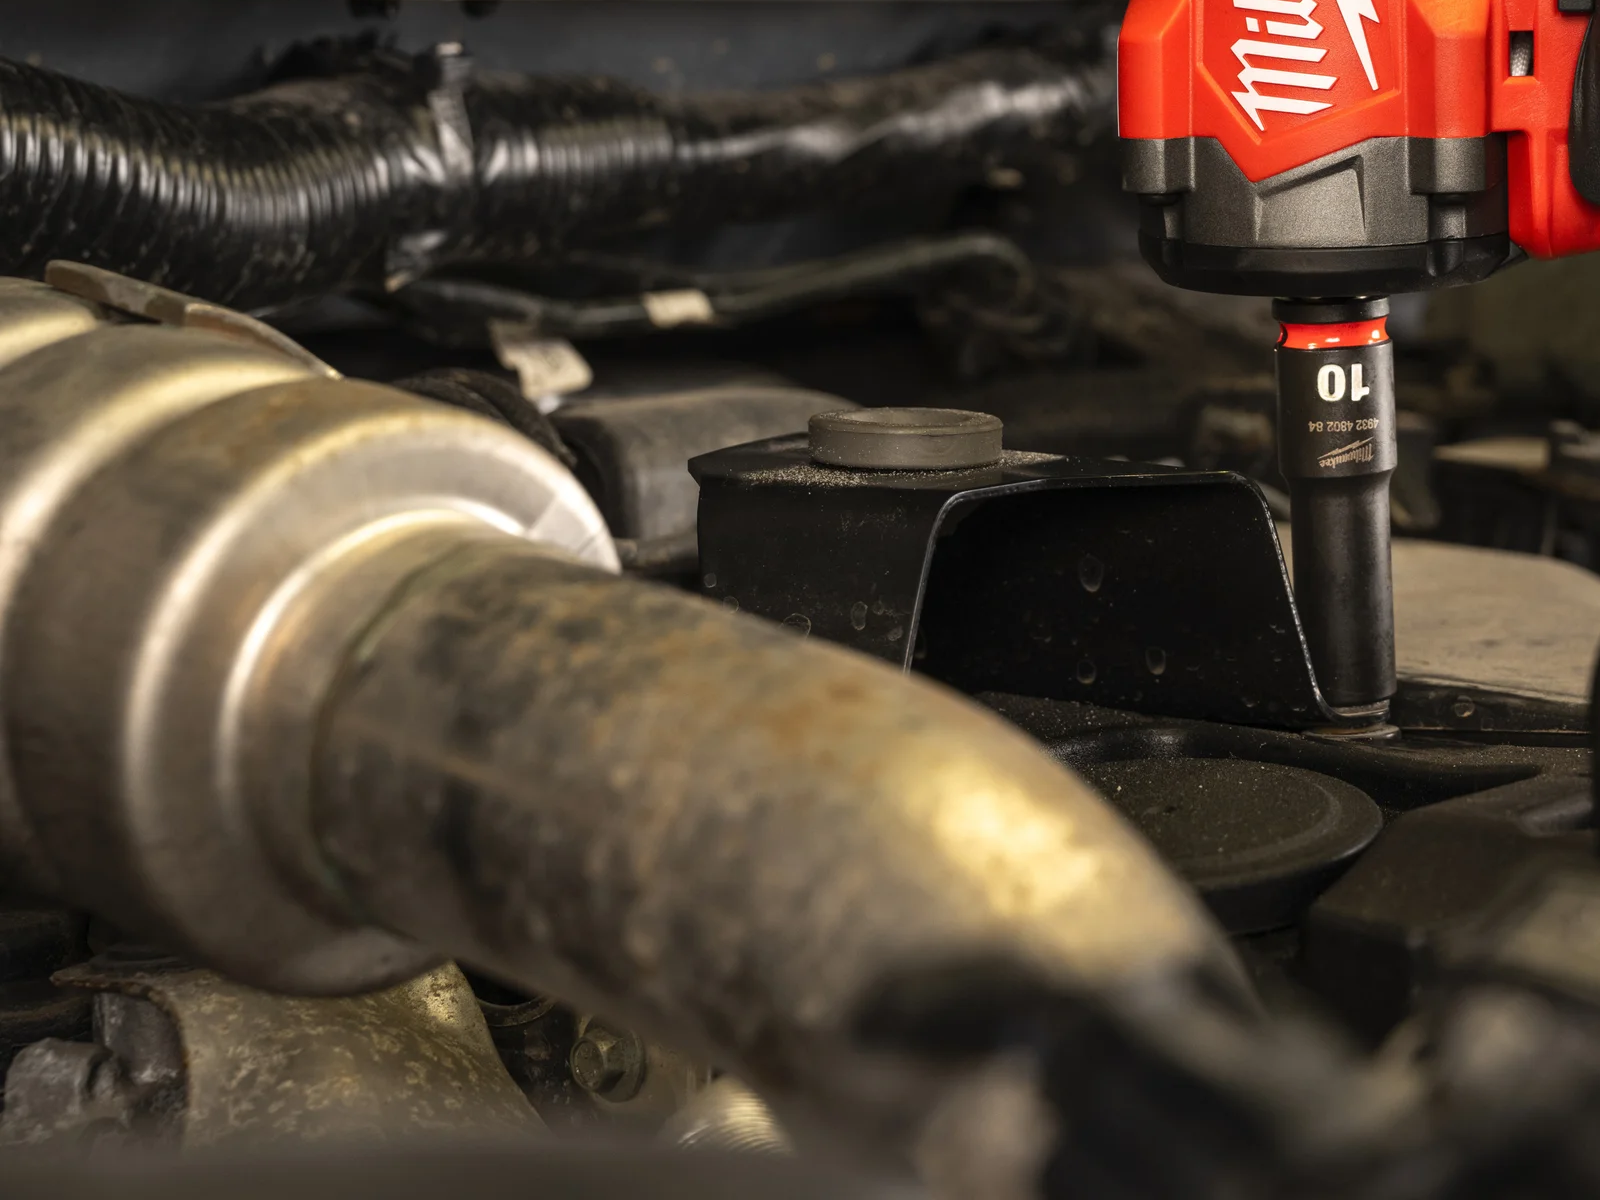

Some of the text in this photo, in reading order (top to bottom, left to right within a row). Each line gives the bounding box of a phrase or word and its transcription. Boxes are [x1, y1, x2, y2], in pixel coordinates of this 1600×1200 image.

[1317, 363, 1370, 402] 10
[1308, 417, 1380, 433] 4932 4802 84
[1319, 443, 1374, 469] Milwaukee
